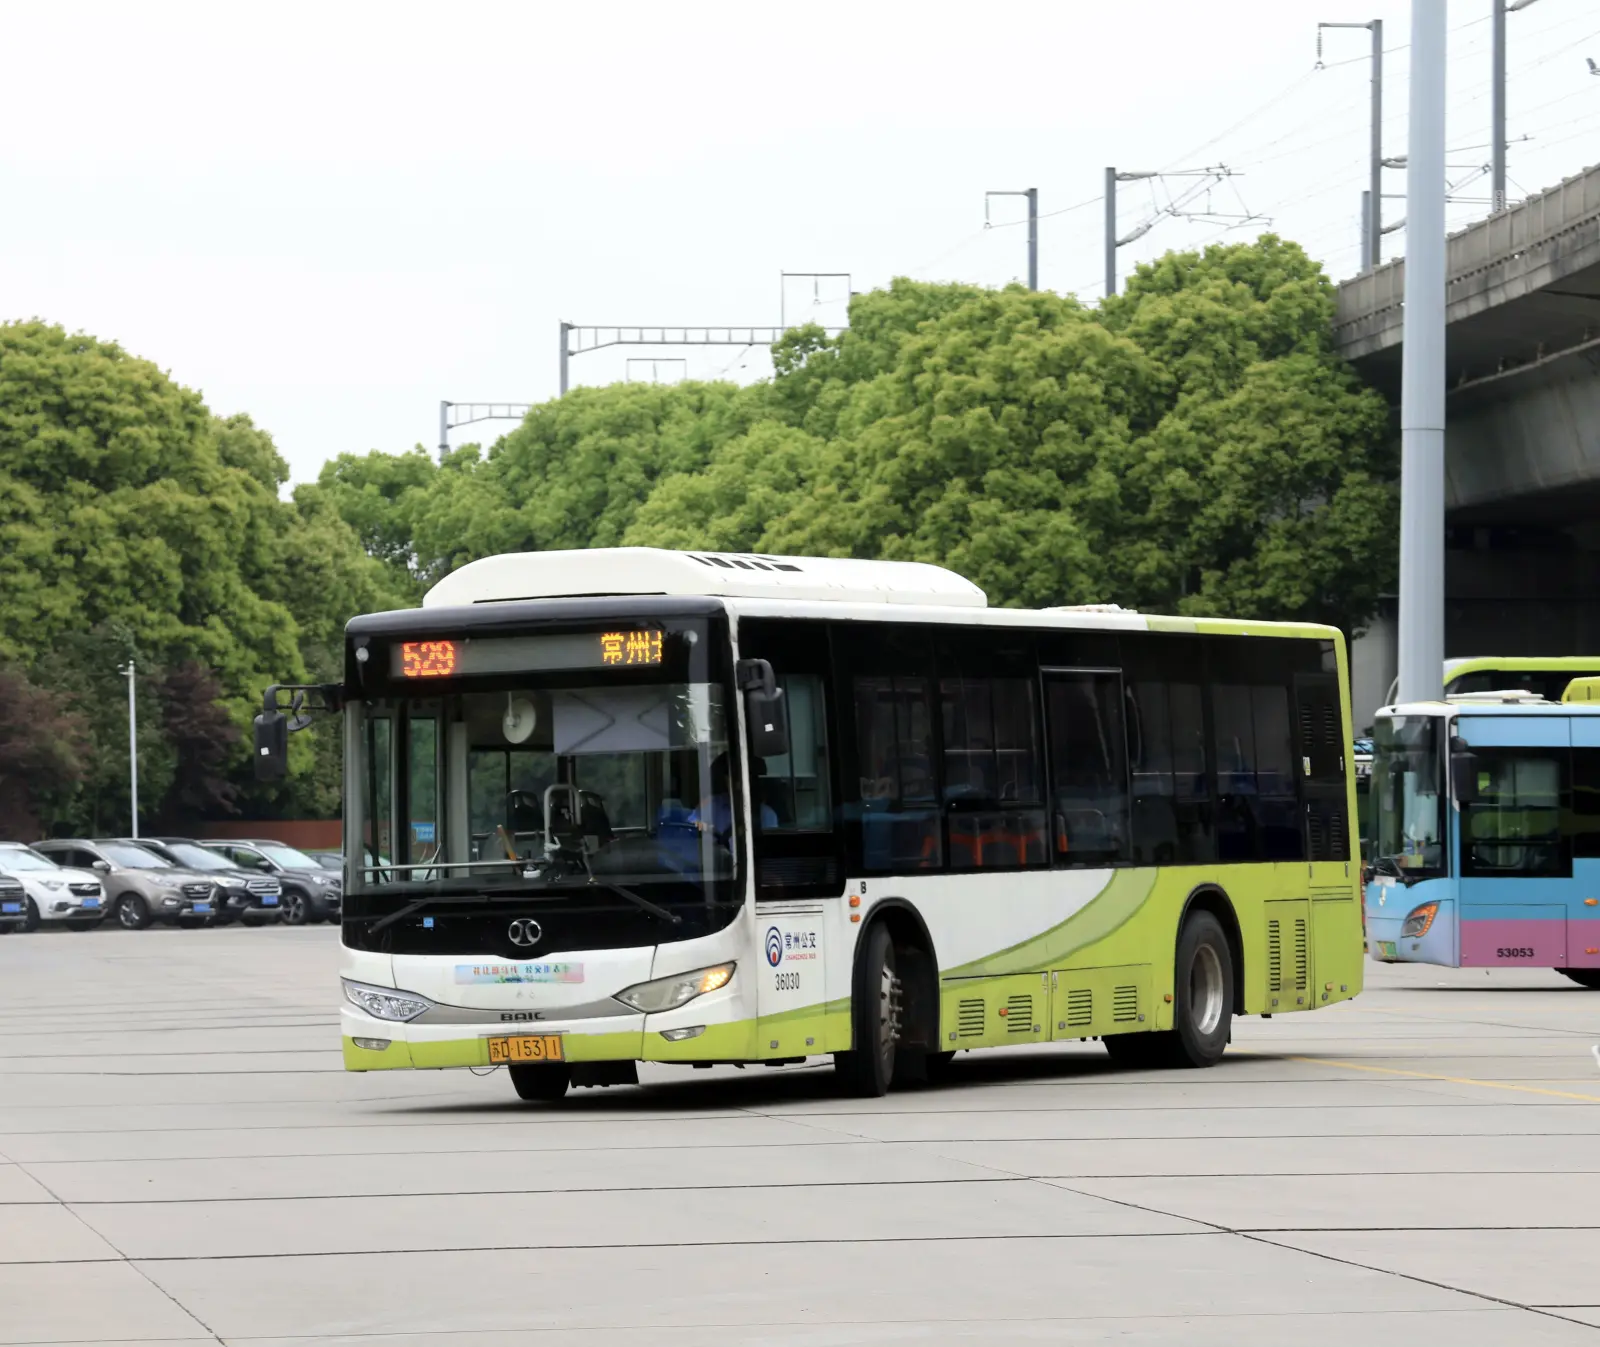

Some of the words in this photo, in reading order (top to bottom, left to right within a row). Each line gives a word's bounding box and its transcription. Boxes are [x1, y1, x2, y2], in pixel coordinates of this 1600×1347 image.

[403, 641, 453, 676] 529
[785, 931, 816, 950] 常州公交
[1497, 947, 1535, 958] 53053
[775, 972, 800, 991] 36030
[500, 1012, 546, 1021] BAIC
